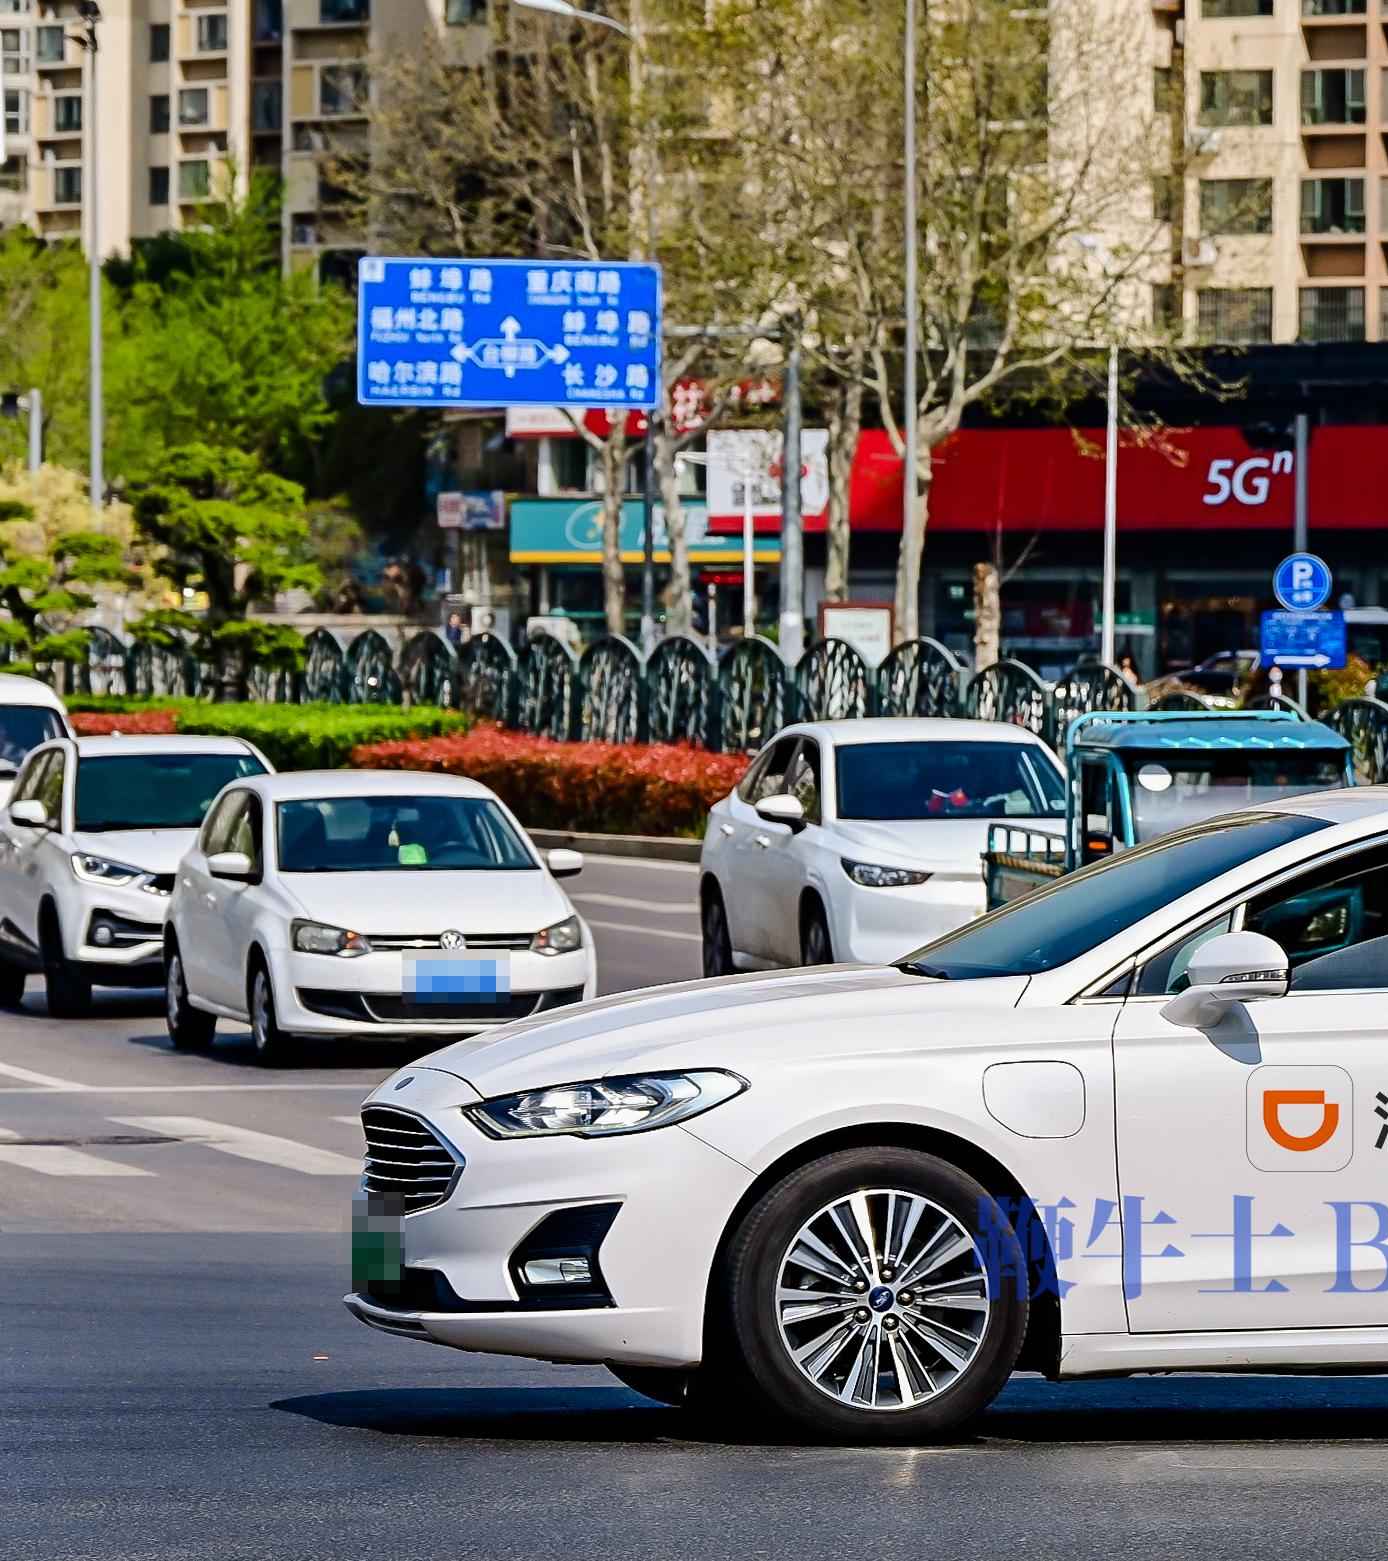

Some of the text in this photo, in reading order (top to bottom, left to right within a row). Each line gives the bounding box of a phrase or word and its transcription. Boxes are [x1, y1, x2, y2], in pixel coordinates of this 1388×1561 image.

[527, 268, 621, 293] 重庆南路
[371, 306, 464, 332] 福州北路
[367, 360, 464, 386] 哈尔滨路
[562, 362, 650, 389] 长沙路
[1292, 561, 1314, 591] P
